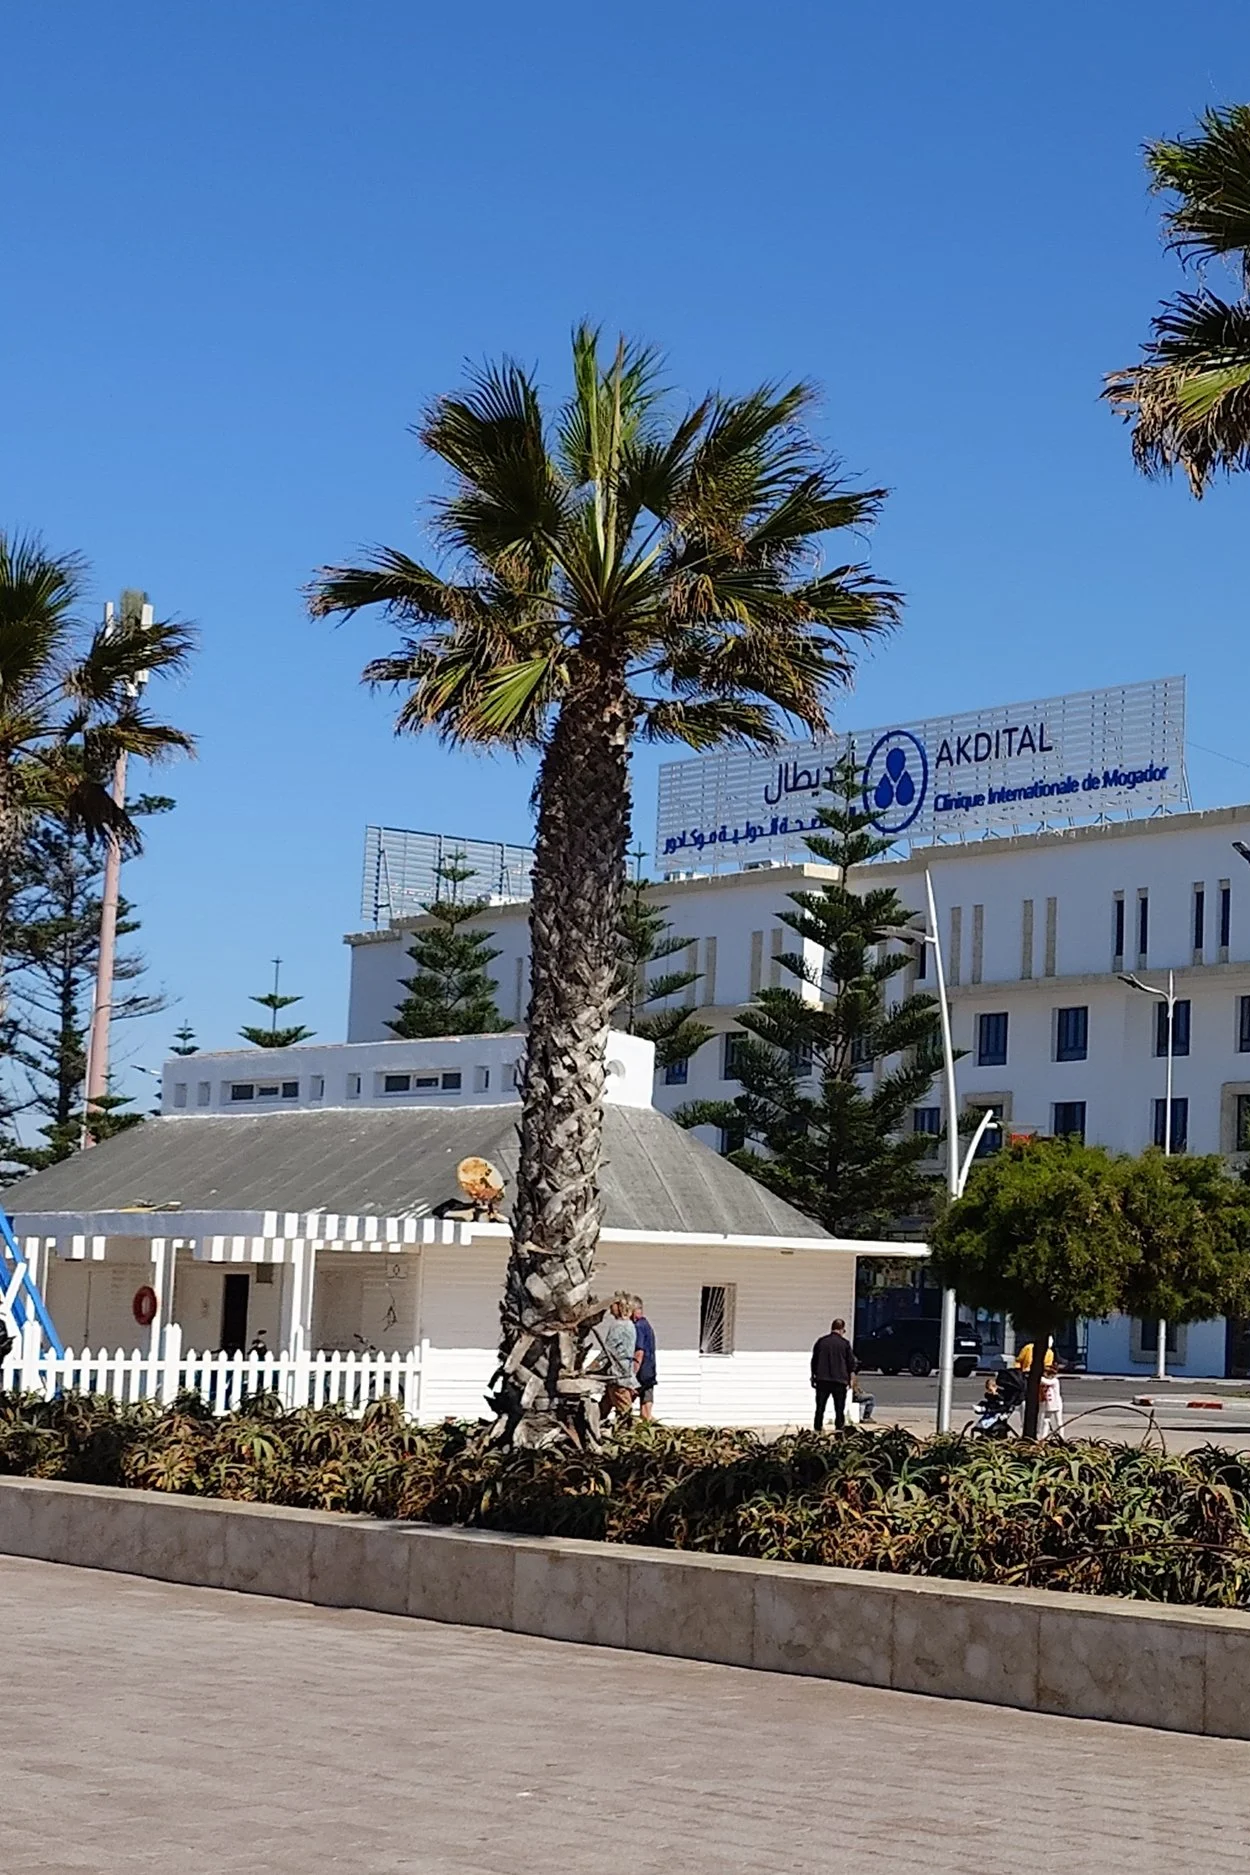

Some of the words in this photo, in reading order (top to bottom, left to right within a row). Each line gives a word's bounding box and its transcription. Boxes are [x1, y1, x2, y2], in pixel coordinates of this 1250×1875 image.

[935, 722, 1053, 769] AKDITAL
[934, 791, 985, 812] Clinique
[988, 778, 1079, 805] Internationale
[1082, 773, 1101, 791] de
[1101, 763, 1169, 789] Mogador
[718, 815, 778, 844] الدولية
